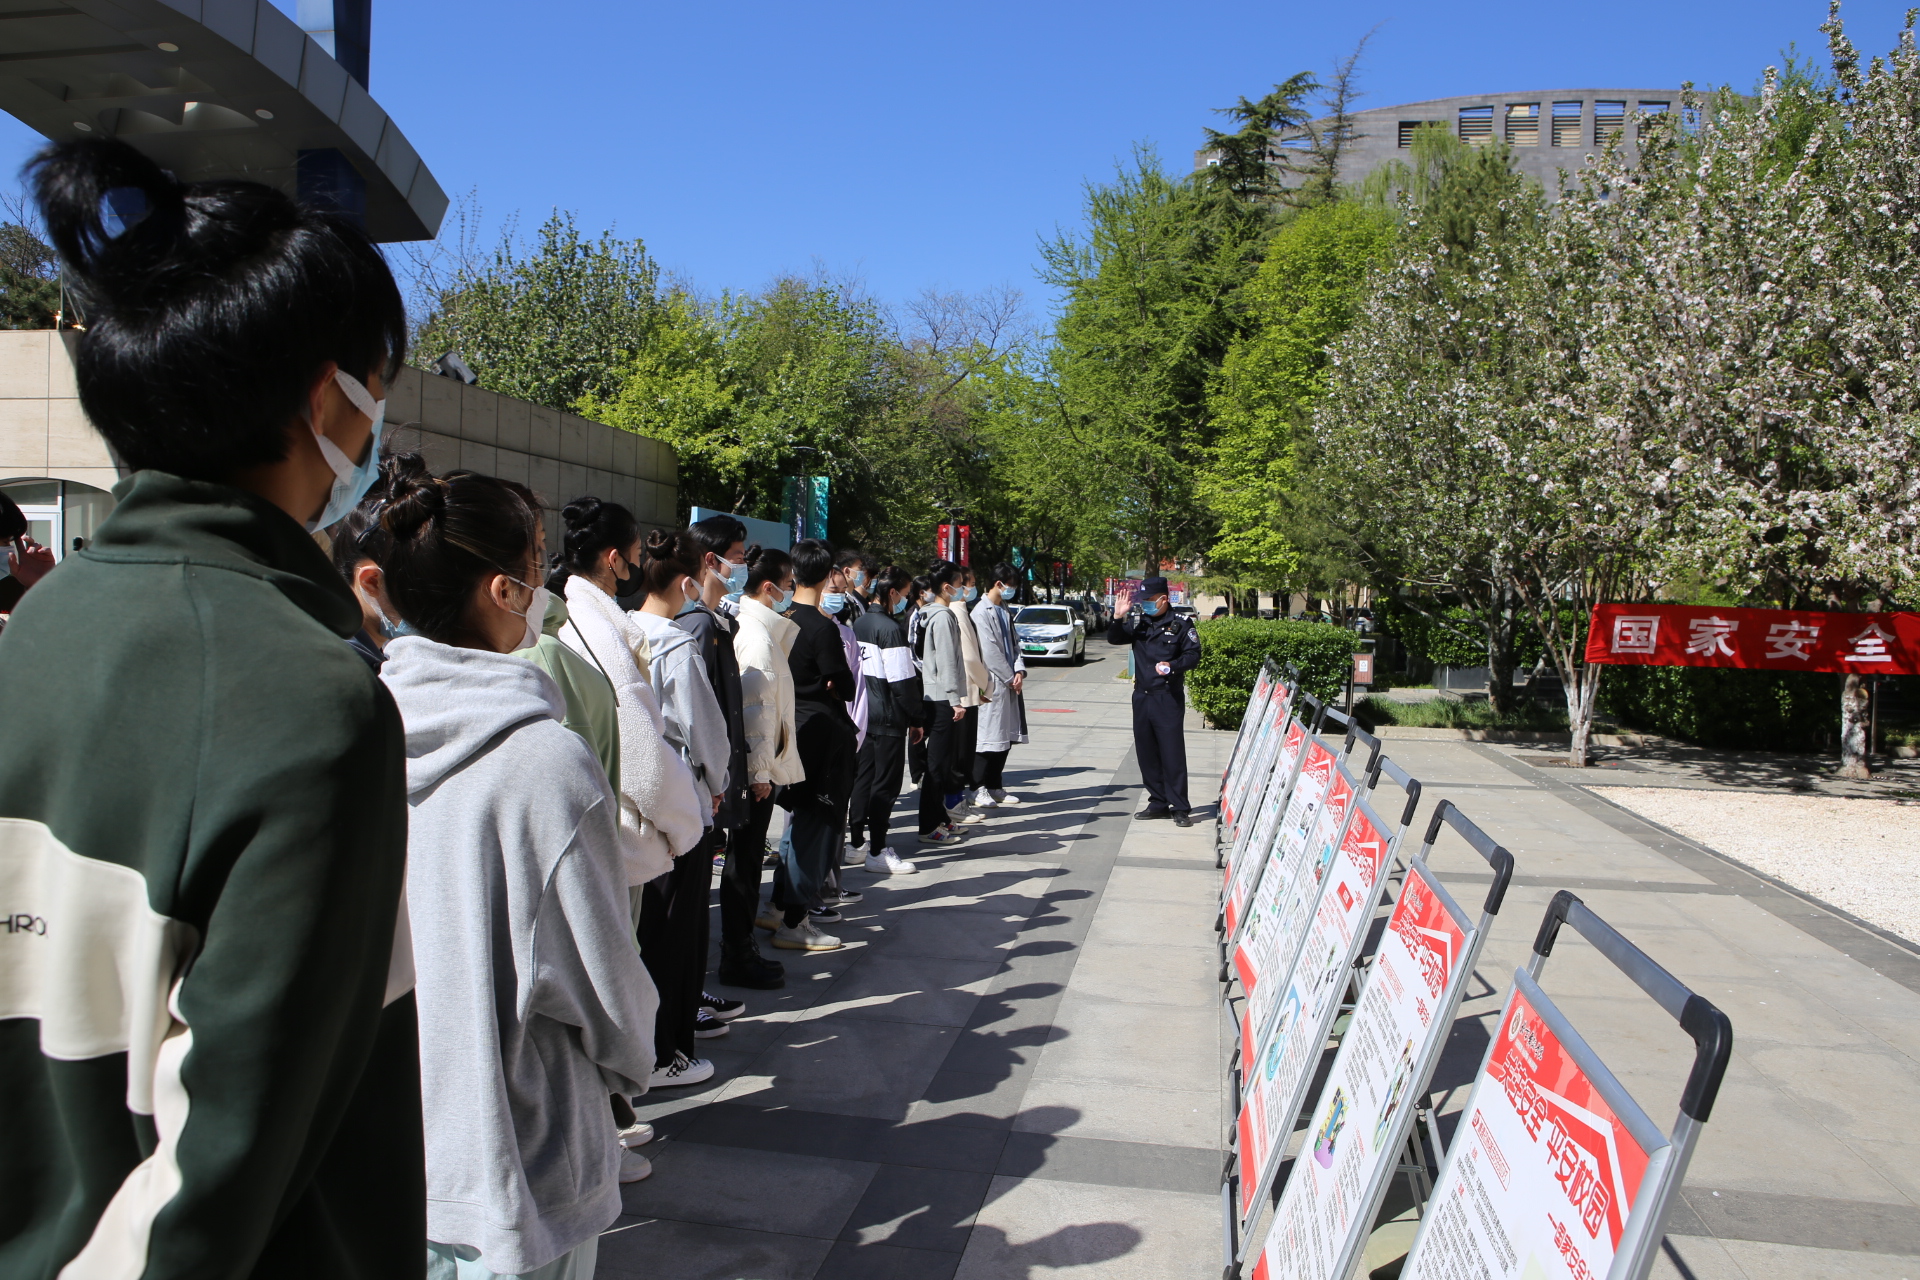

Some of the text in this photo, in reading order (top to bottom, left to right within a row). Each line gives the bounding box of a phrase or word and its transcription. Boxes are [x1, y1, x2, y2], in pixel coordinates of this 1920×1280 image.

[1611, 615, 1895, 663] 国家安全
[1499, 1050, 1548, 1143] 关注安全
[1547, 1117, 1610, 1239] 平安校园
